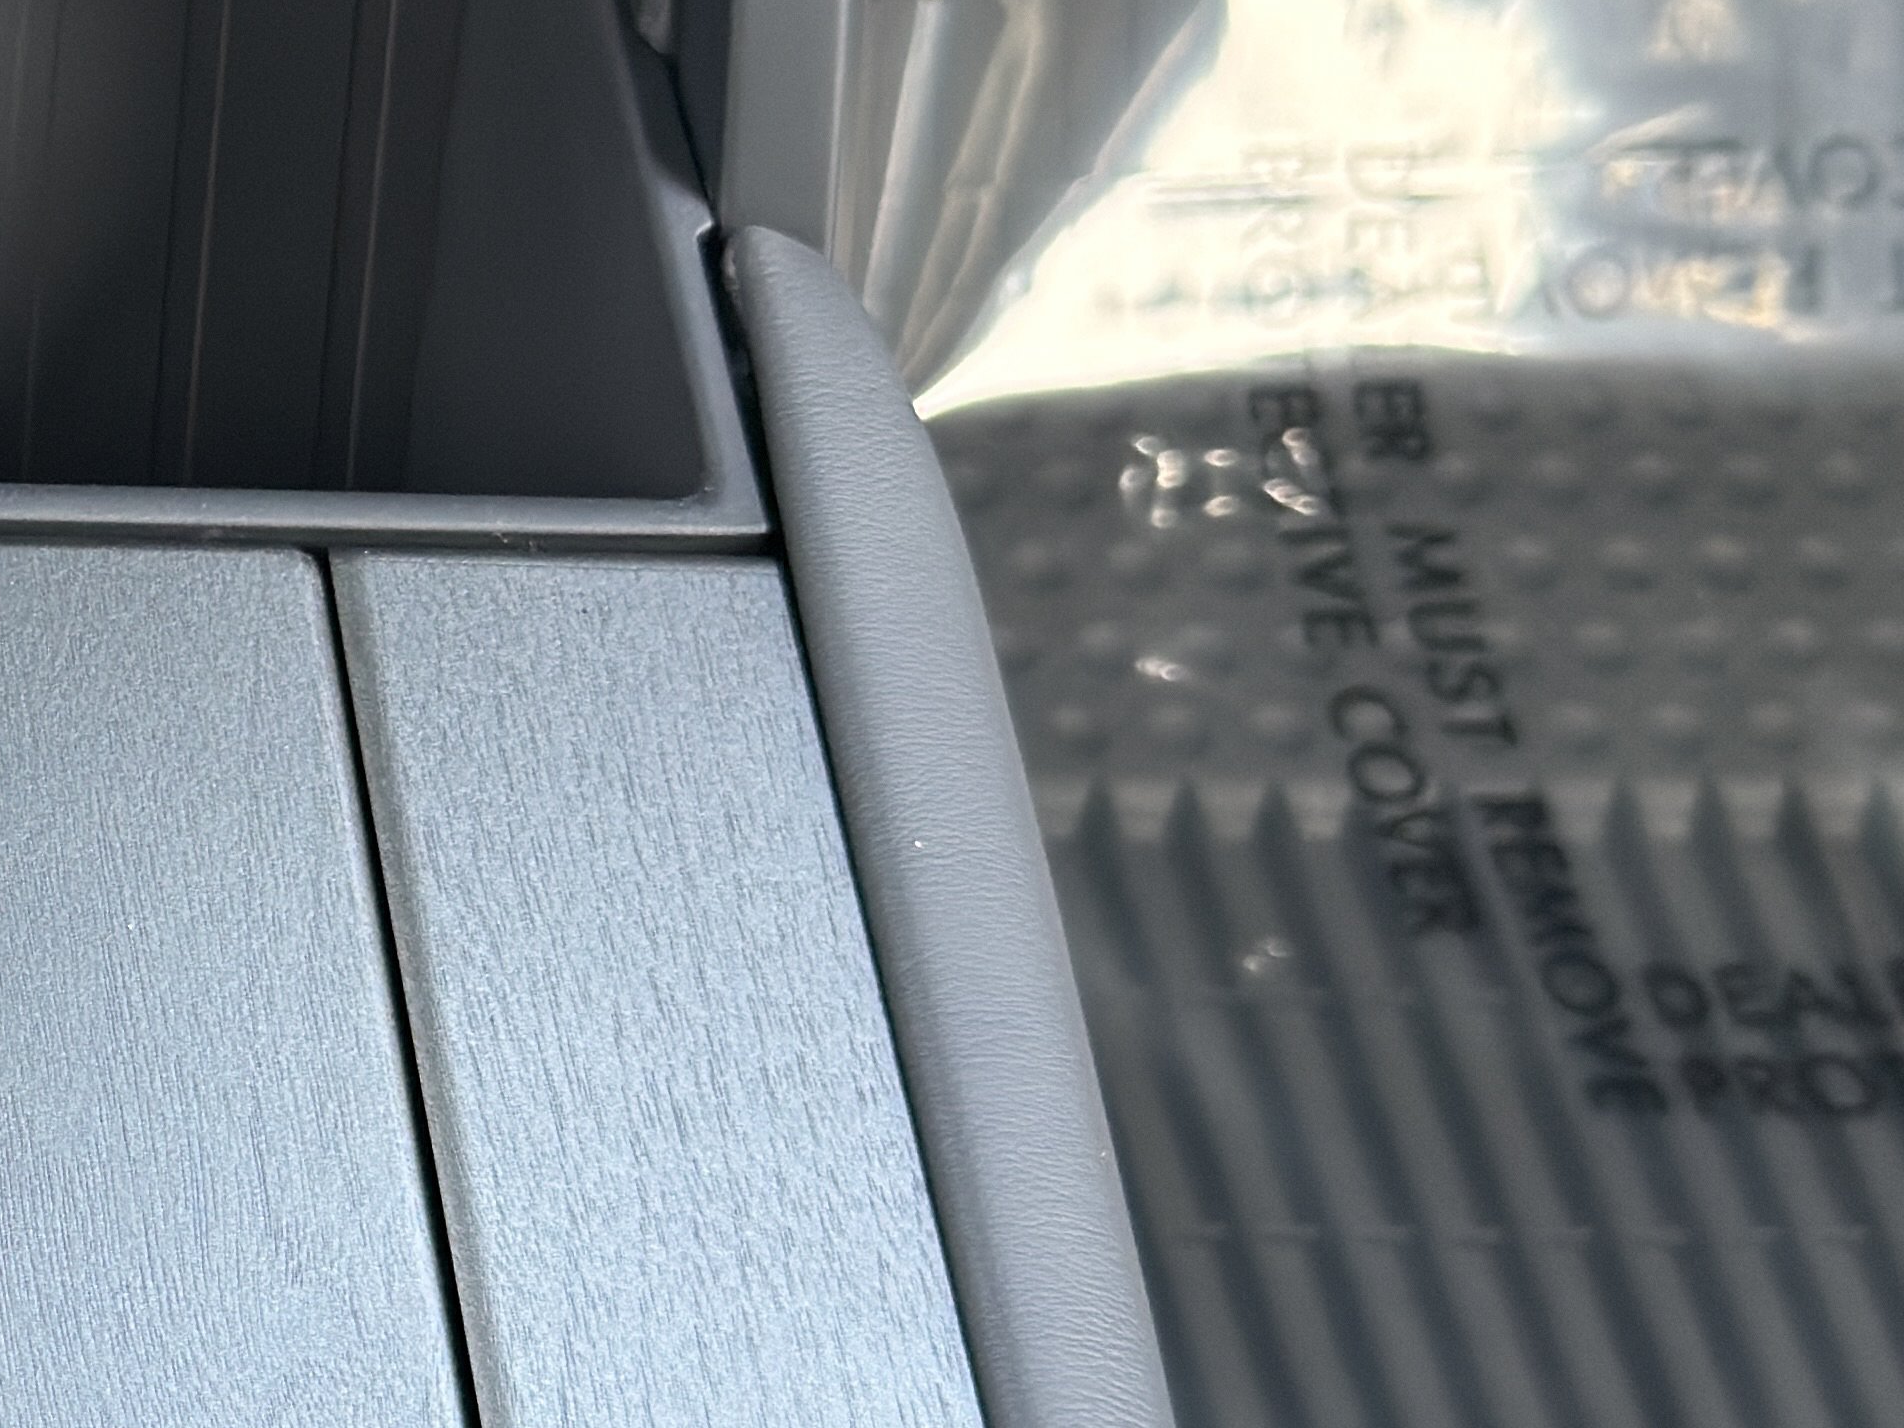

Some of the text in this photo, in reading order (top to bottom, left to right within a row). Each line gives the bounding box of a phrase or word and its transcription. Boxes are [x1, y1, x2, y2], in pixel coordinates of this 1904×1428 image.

[1328, 683, 1482, 940] COVER
[1387, 521, 1518, 749] MUST
[1473, 789, 1671, 1116] REMOVE
